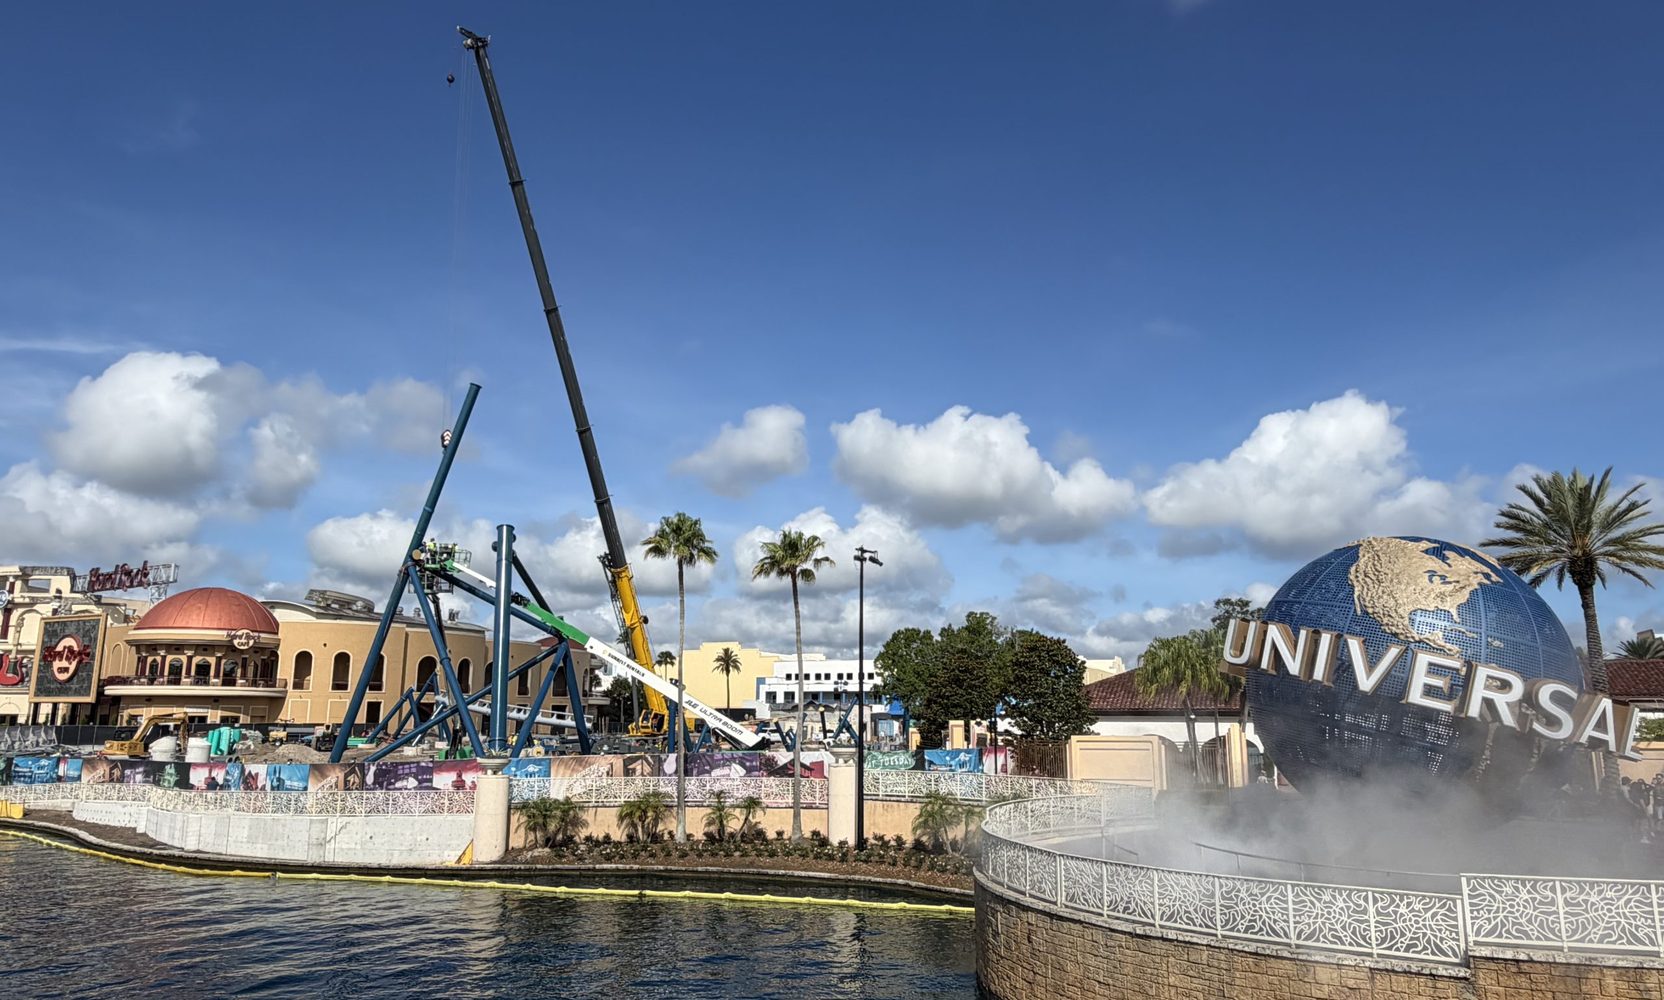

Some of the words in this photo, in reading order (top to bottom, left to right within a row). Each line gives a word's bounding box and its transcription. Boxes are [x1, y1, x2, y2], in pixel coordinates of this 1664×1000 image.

[225, 631, 244, 640] Hard
[244, 632, 261, 642] Rock
[1222, 618, 1644, 761] UNIVERSAL
[684, 699, 700, 709] JLG
[699, 707, 723, 723] ULTRA
[722, 721, 744, 736] BOOM
